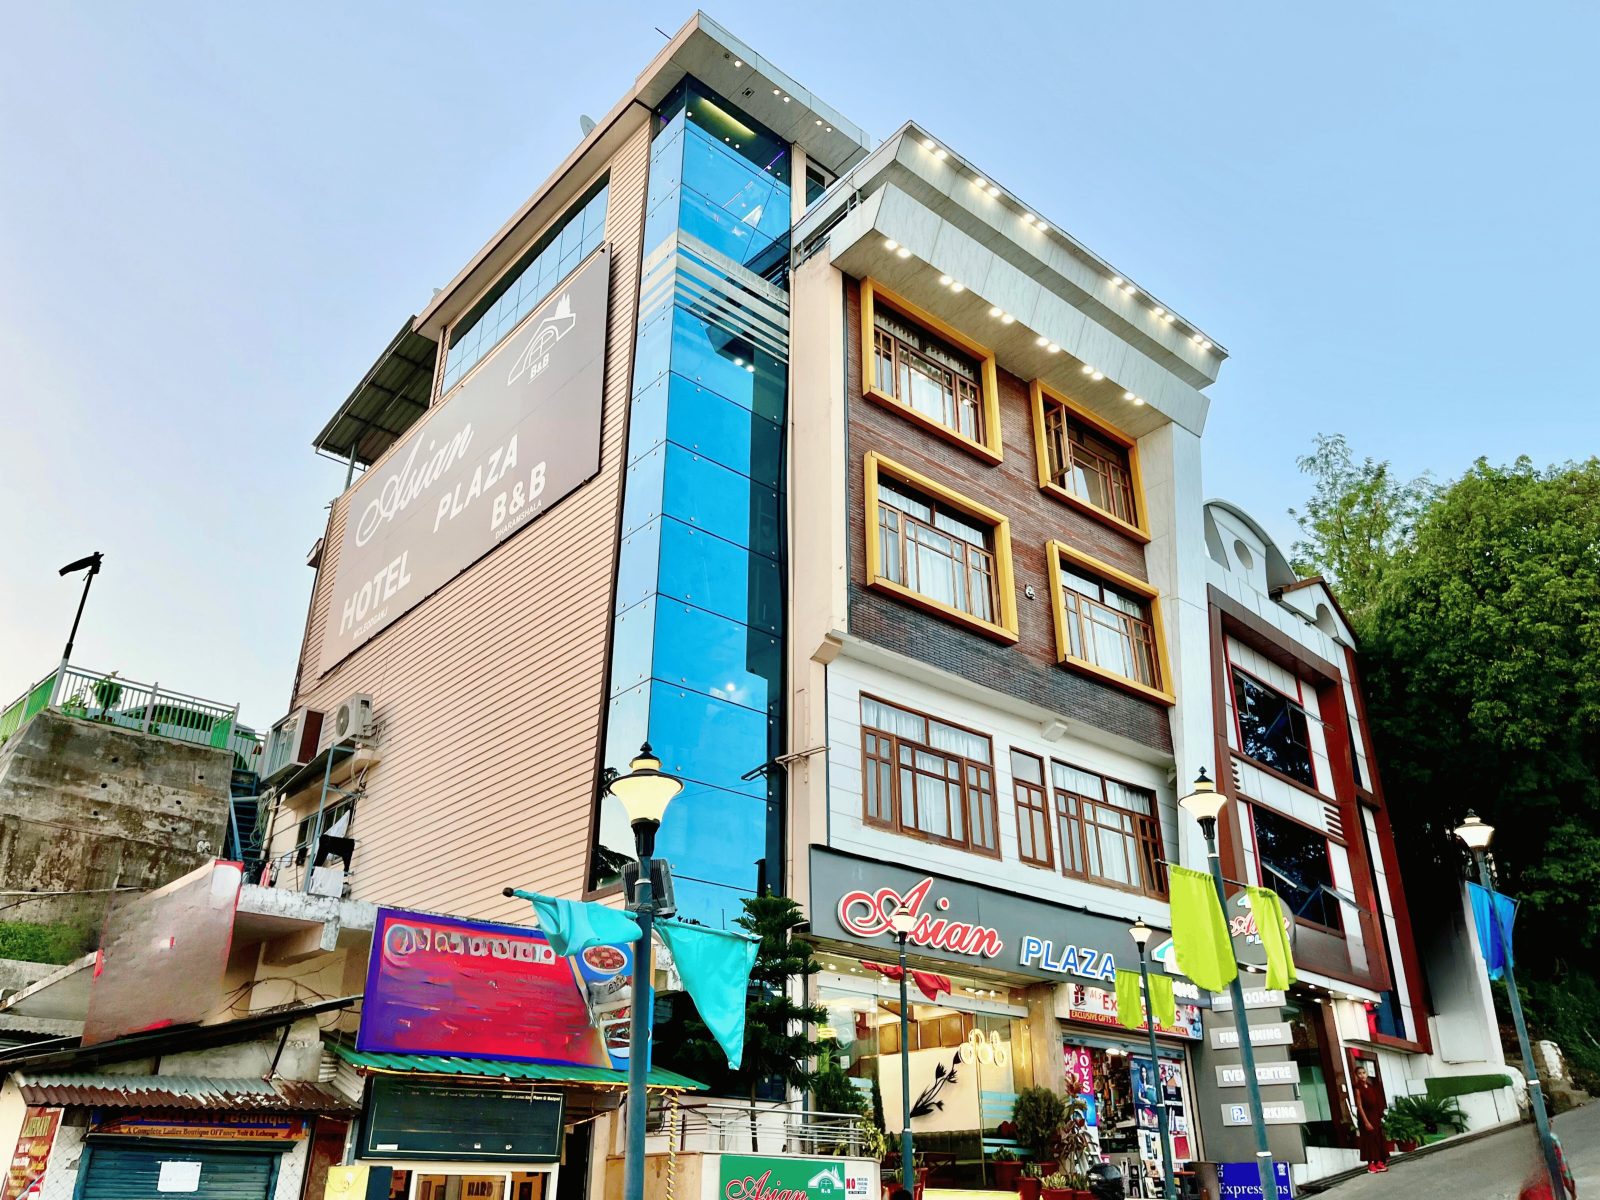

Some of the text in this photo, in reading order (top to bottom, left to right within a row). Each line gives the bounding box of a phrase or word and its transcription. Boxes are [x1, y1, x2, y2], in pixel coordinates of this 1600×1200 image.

[355, 422, 474, 547] Asian
[432, 433, 518, 534] PLAZA
[490, 461, 547, 532] B&B
[339, 549, 412, 637] HOTEL
[838, 876, 1116, 983] Asian PLAZA
[1244, 990, 1278, 1004] OOMS
[1071, 1011, 1098, 1024] EXCLUSIVE
[1219, 1031, 1239, 1043] FIN
[1263, 1107, 1297, 1120] RKING
[846, 1177, 856, 1189] NO
[1219, 1182, 1289, 1198] Expressns
